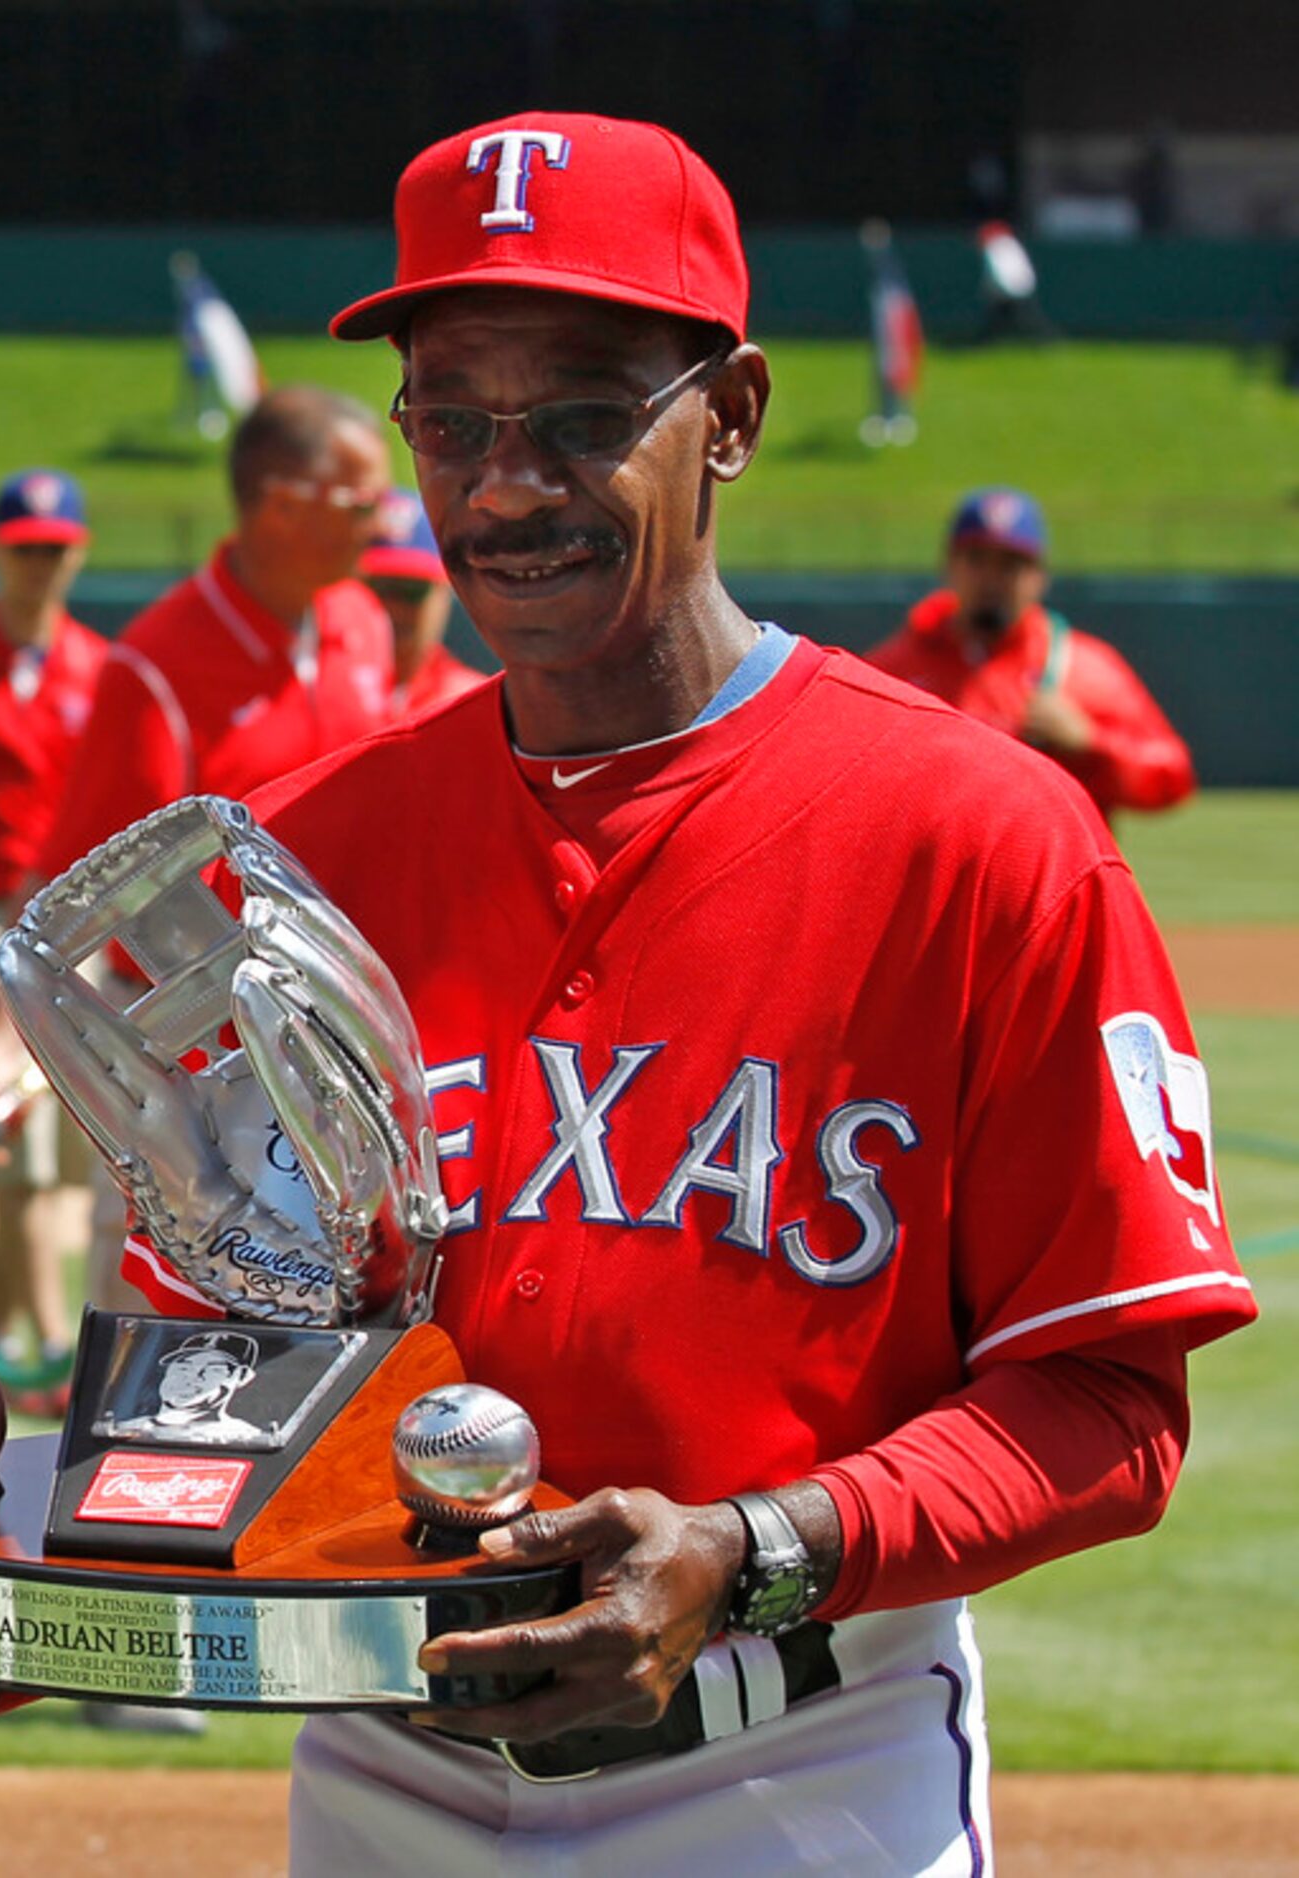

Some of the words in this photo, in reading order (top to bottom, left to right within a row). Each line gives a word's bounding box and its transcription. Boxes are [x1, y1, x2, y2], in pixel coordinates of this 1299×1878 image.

[466, 129, 571, 234] T
[208, 1226, 334, 1297] Rawlings
[1, 1586, 72, 1607] RAWLINGS
[75, 1595, 153, 1613] PLATINUM
[154, 1602, 204, 1618] GLOVE
[142, 1616, 158, 1627] TO
[125, 1628, 249, 1662] BELTRE
[19, 1664, 91, 1685] DEFENDER
[94, 1672, 110, 1687] IN
[114, 1674, 141, 1689] THE
[146, 1677, 226, 1694] AMERICAN
[52, 1653, 76, 1668] HIS
[78, 1655, 156, 1676] SELECTION
[160, 1661, 178, 1676] BY
[183, 1663, 211, 1678] THE
[214, 1665, 254, 1680] FANS
[259, 1668, 276, 1681] AS
